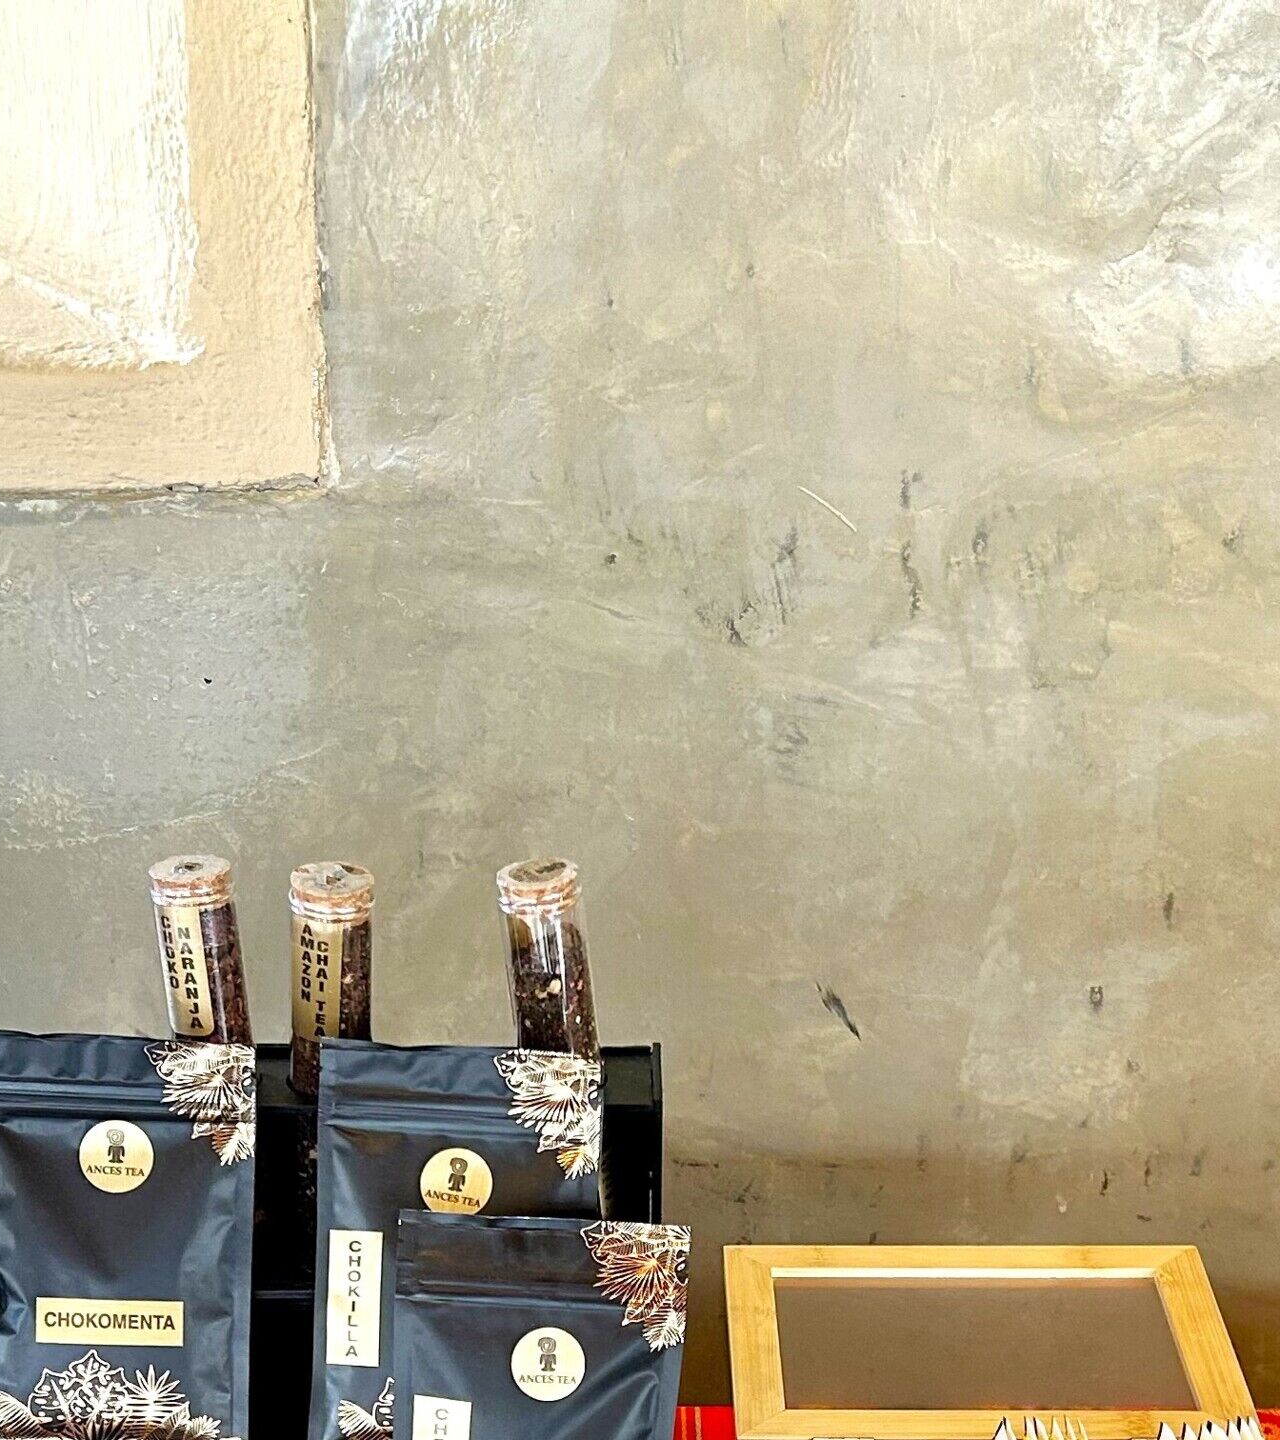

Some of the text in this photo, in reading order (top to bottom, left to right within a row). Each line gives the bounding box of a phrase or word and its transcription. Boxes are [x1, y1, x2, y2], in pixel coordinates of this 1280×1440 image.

[160, 915, 180, 989] CHOKO
[177, 927, 204, 1030] NARANJA
[300, 923, 315, 1003] AMAZON
[314, 941, 329, 1037] CHAI TEA
[86, 1164, 145, 1177] ANCES TEA
[424, 1188, 481, 1208] ANCES TEA
[44, 1311, 176, 1331] CHOKOMENTA
[345, 1240, 362, 1358] CHOKILLA
[519, 1374, 577, 1385] ANCES TEA
